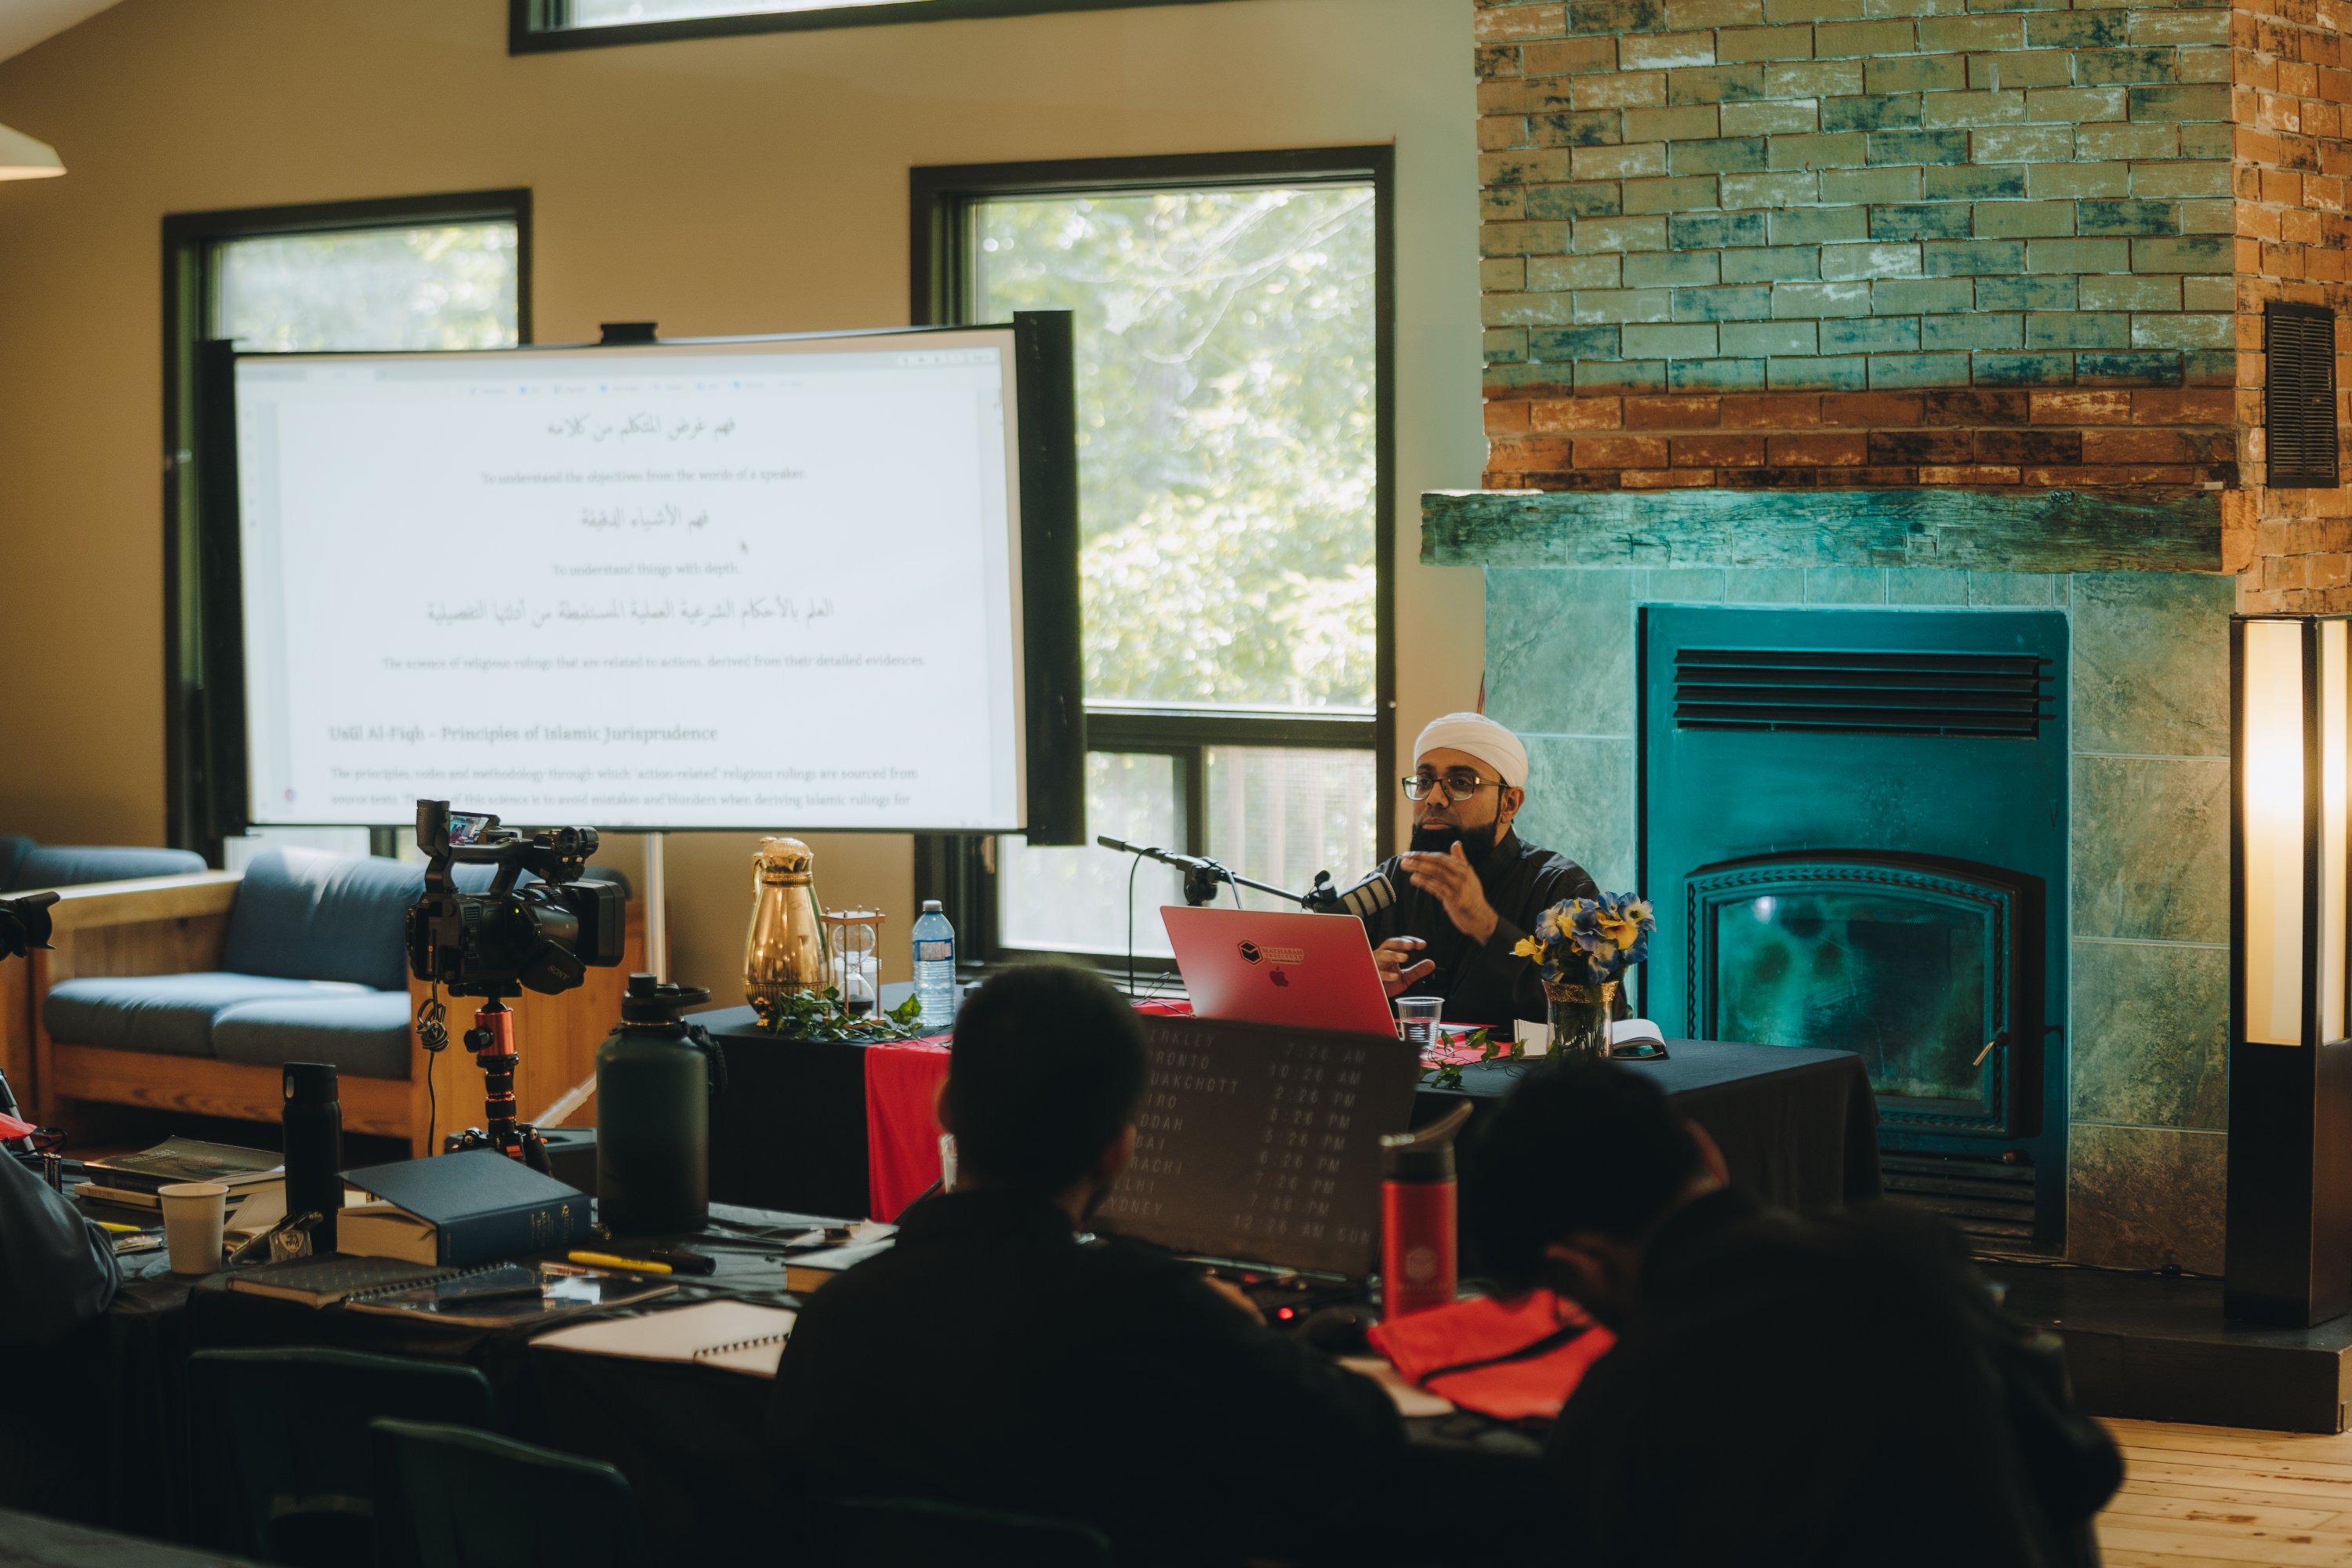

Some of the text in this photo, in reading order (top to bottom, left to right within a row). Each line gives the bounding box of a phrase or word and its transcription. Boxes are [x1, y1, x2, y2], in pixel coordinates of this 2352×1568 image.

[593, 426, 614, 443] من
[714, 417, 736, 443] فهم
[481, 471, 497, 484] To
[498, 470, 564, 485] understand
[564, 470, 584, 484] the
[586, 470, 644, 484] objectives
[646, 470, 675, 481] from
[676, 469, 695, 481] the
[698, 468, 733, 481] words
[735, 467, 747, 481] of
[750, 471, 757, 481] a
[688, 510, 710, 534] فهم
[552, 562, 567, 575] To
[568, 563, 634, 576] understand
[637, 562, 673, 578] things
[675, 562, 702, 575] with
[532, 612, 552, 629] من
[382, 657, 404, 670] The
[405, 659, 446, 670] science
[448, 656, 460, 670] of
[463, 656, 511, 673] religious
[514, 656, 554, 671] rulings
[556, 656, 579, 669] that
[582, 659, 601, 669] are
[603, 655, 644, 669] related
[644, 657, 658, 668] to
[706, 655, 751, 668] derived
[753, 655, 782, 667] from
[783, 654, 813, 667] their
[815, 653, 862, 667] detailed
[440, 724, 521, 746] Principles
[524, 724, 541, 742] of
[543, 724, 601, 742] Islamic
[603, 724, 718, 746] Jurisprudence
[330, 767, 352, 779] The
[415, 768, 446, 780] codes
[448, 770, 470, 780] and
[472, 767, 546, 783] methodology
[548, 767, 594, 783] through
[597, 767, 631, 780] which
[722, 766, 774, 783] religious
[775, 767, 817, 783] rulings
[819, 770, 839, 780] are
[840, 766, 887, 780] sourced
[888, 766, 918, 780] from
[332, 795, 368, 805] source
[464, 793, 485, 805] this
[487, 794, 529, 805] science
[531, 795, 541, 805] is
[543, 794, 556, 805] to
[557, 793, 589, 806] avoid
[590, 793, 641, 806] mistakes
[643, 793, 665, 806] and
[666, 793, 717, 806] blunders
[719, 793, 752, 806] when
[754, 793, 804, 809] deriving
[805, 793, 846, 806] Islamic
[849, 792, 891, 809] rulings
[893, 792, 911, 806] for
[547, 965, 571, 980] SONY
[1150, 1029, 1216, 1047] ERKLEY
[1342, 1050, 1367, 1065] AM
[1154, 1051, 1210, 1071] RONTO
[1338, 1071, 1362, 1086] AM
[1149, 1071, 1240, 1094] UAKCHOTT
[1332, 1091, 1357, 1107] PM
[1148, 1094, 1178, 1111] IRO
[1327, 1113, 1352, 1130] PM
[1140, 1114, 1184, 1131] DDAH
[1322, 1135, 1346, 1151] PM
[1134, 1135, 1167, 1152] BAI
[1317, 1156, 1341, 1173] PM
[1128, 1156, 1183, 1176] RACHI
[1311, 1178, 1337, 1194] PM
[1113, 1178, 1156, 1192] ELHI
[1306, 1201, 1330, 1217] PM
[1109, 1196, 1163, 1218] YDNEY
[1301, 1224, 1324, 1240] AM
